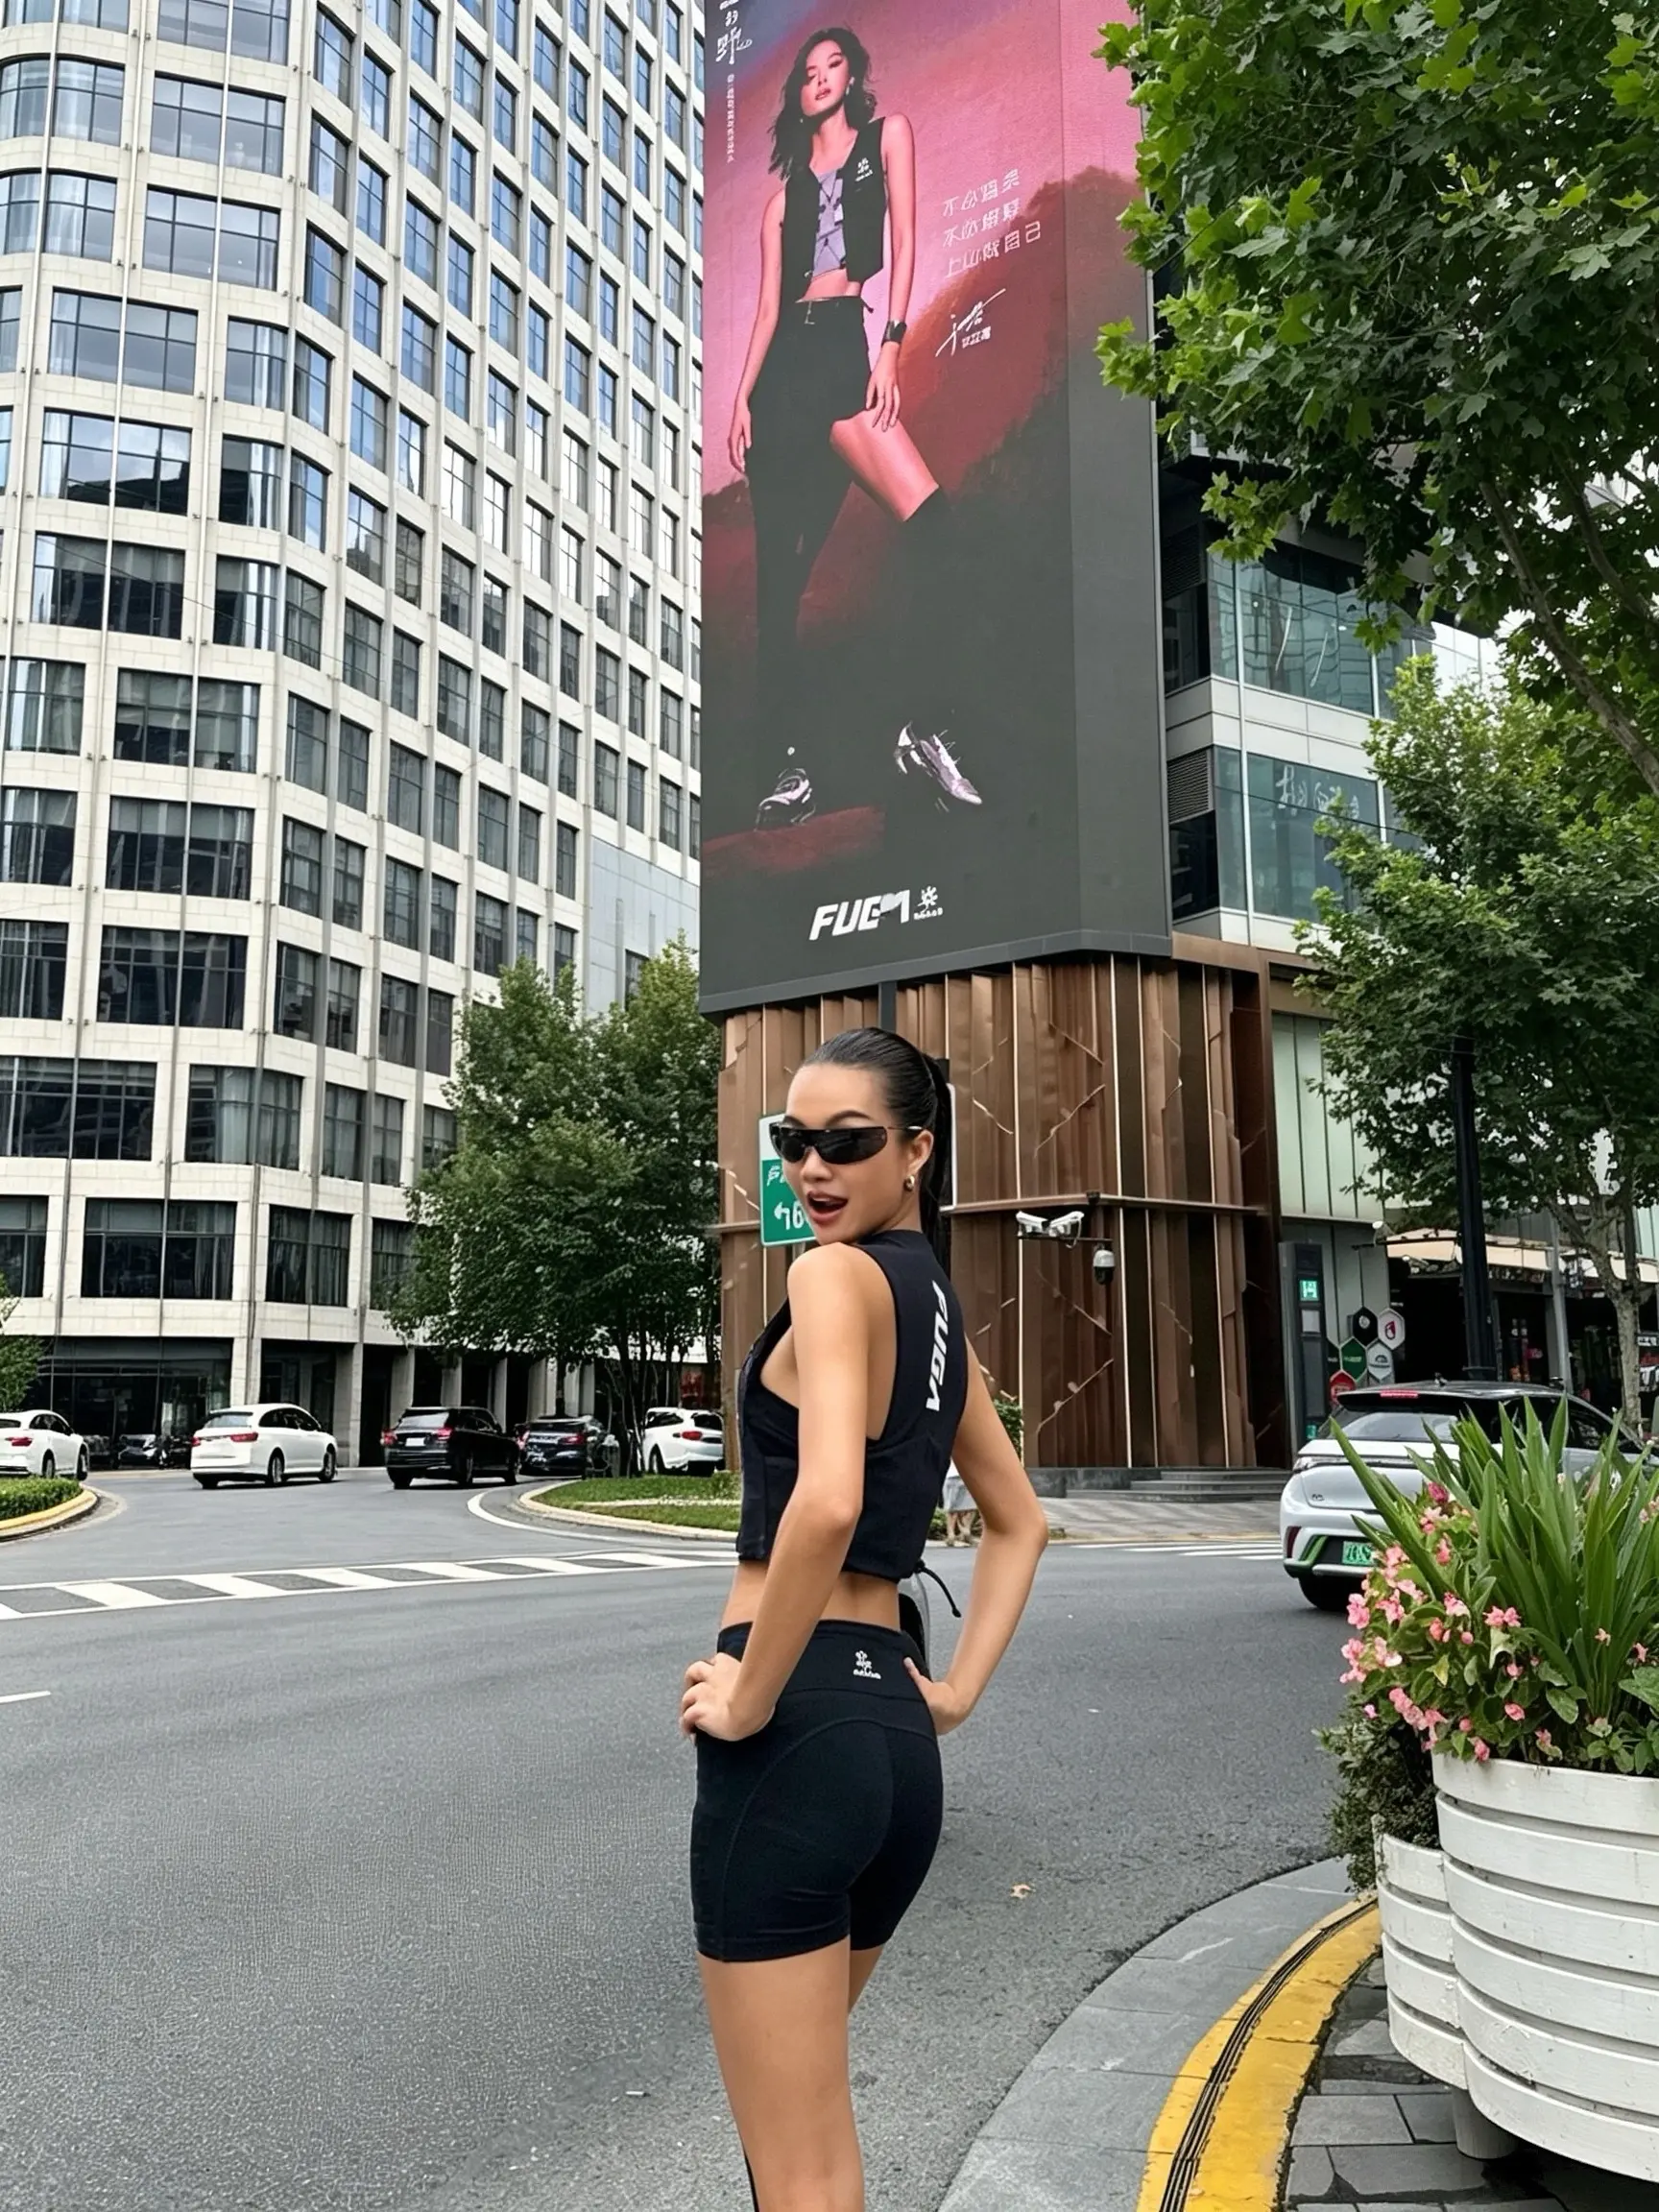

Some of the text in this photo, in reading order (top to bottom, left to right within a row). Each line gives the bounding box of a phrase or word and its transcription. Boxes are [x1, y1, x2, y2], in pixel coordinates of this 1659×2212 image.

[945, 220, 1041, 278] 上山做自己
